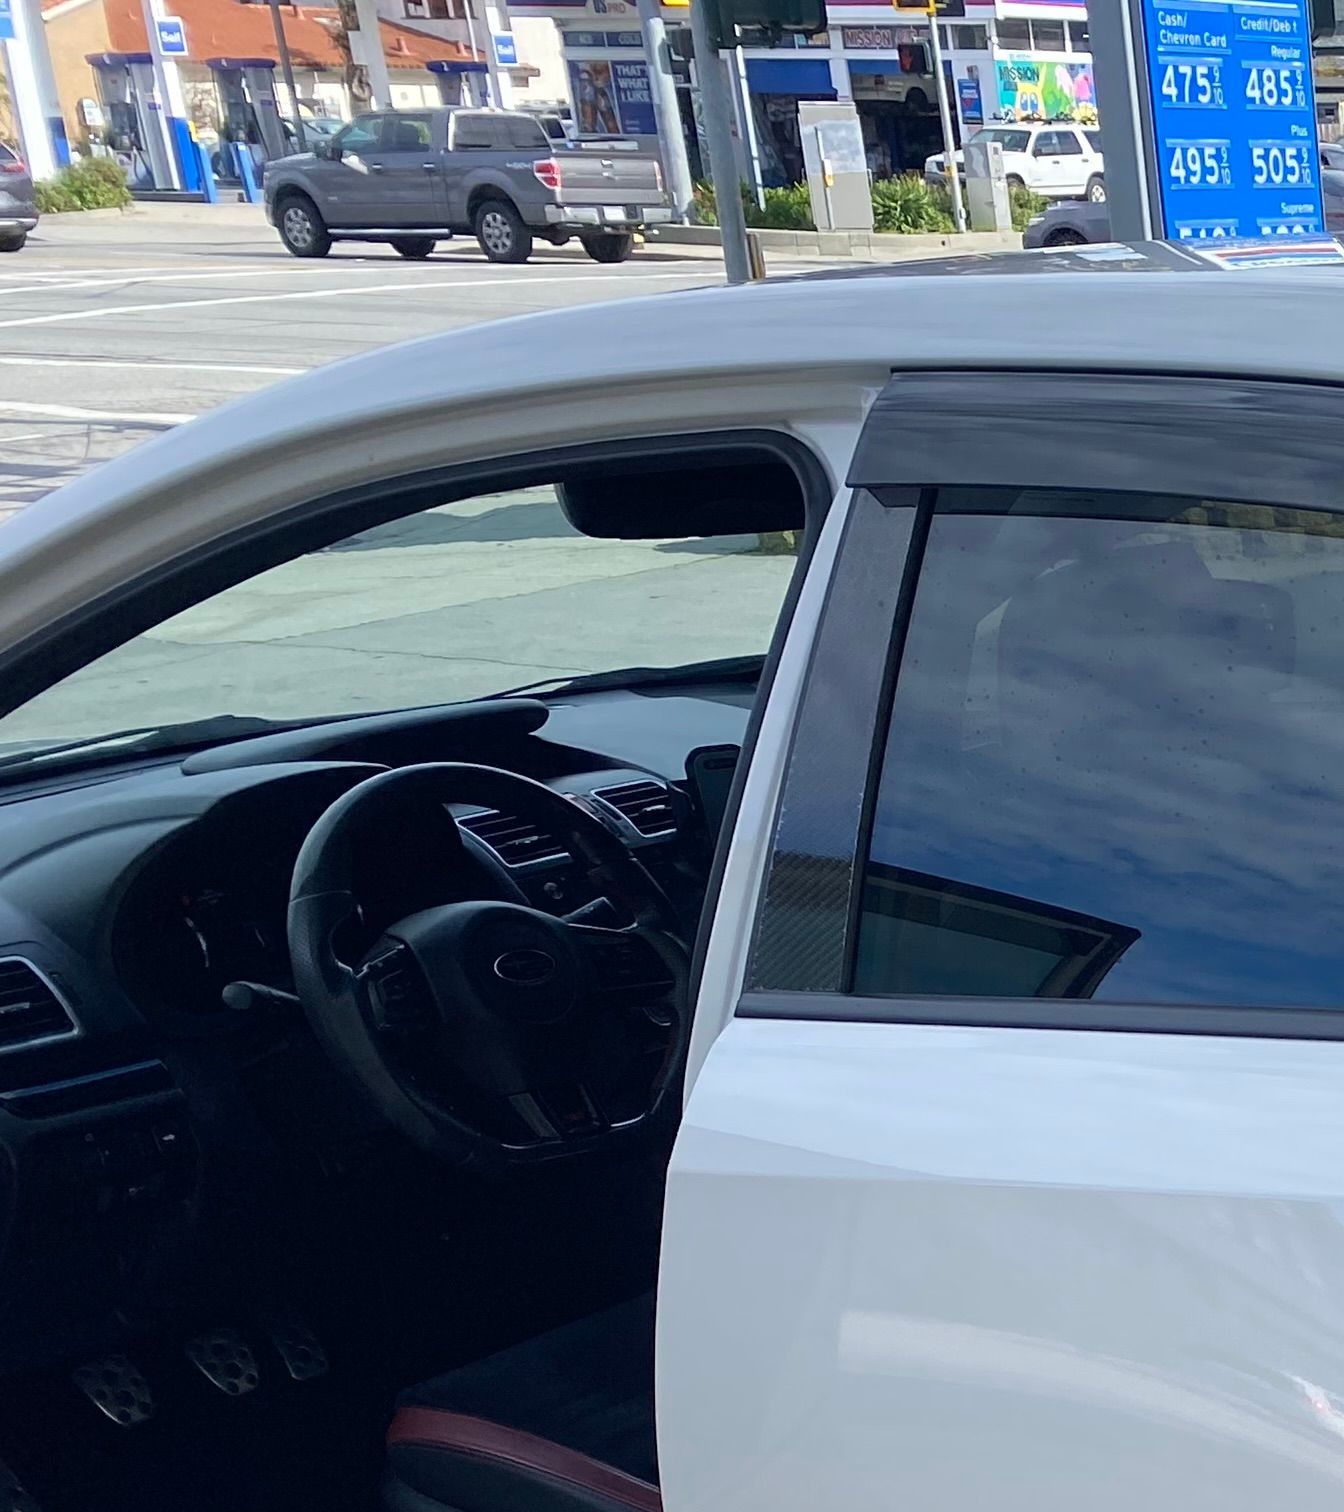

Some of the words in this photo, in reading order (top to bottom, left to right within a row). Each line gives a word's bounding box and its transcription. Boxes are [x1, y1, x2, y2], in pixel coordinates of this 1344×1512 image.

[1158, 11, 1188, 28] Cash/
[1241, 16, 1297, 33] Credit/Debt
[1159, 29, 1201, 46] Chevron
[1203, 32, 1227, 48] Card
[1271, 45, 1301, 60] Regular
[1162, 65, 1212, 104] 475
[1246, 67, 1293, 106] 485
[1290, 124, 1309, 137] Plus
[1170, 146, 1219, 185] 495
[1252, 146, 1301, 185] 505
[1280, 202, 1315, 216] Supreme
